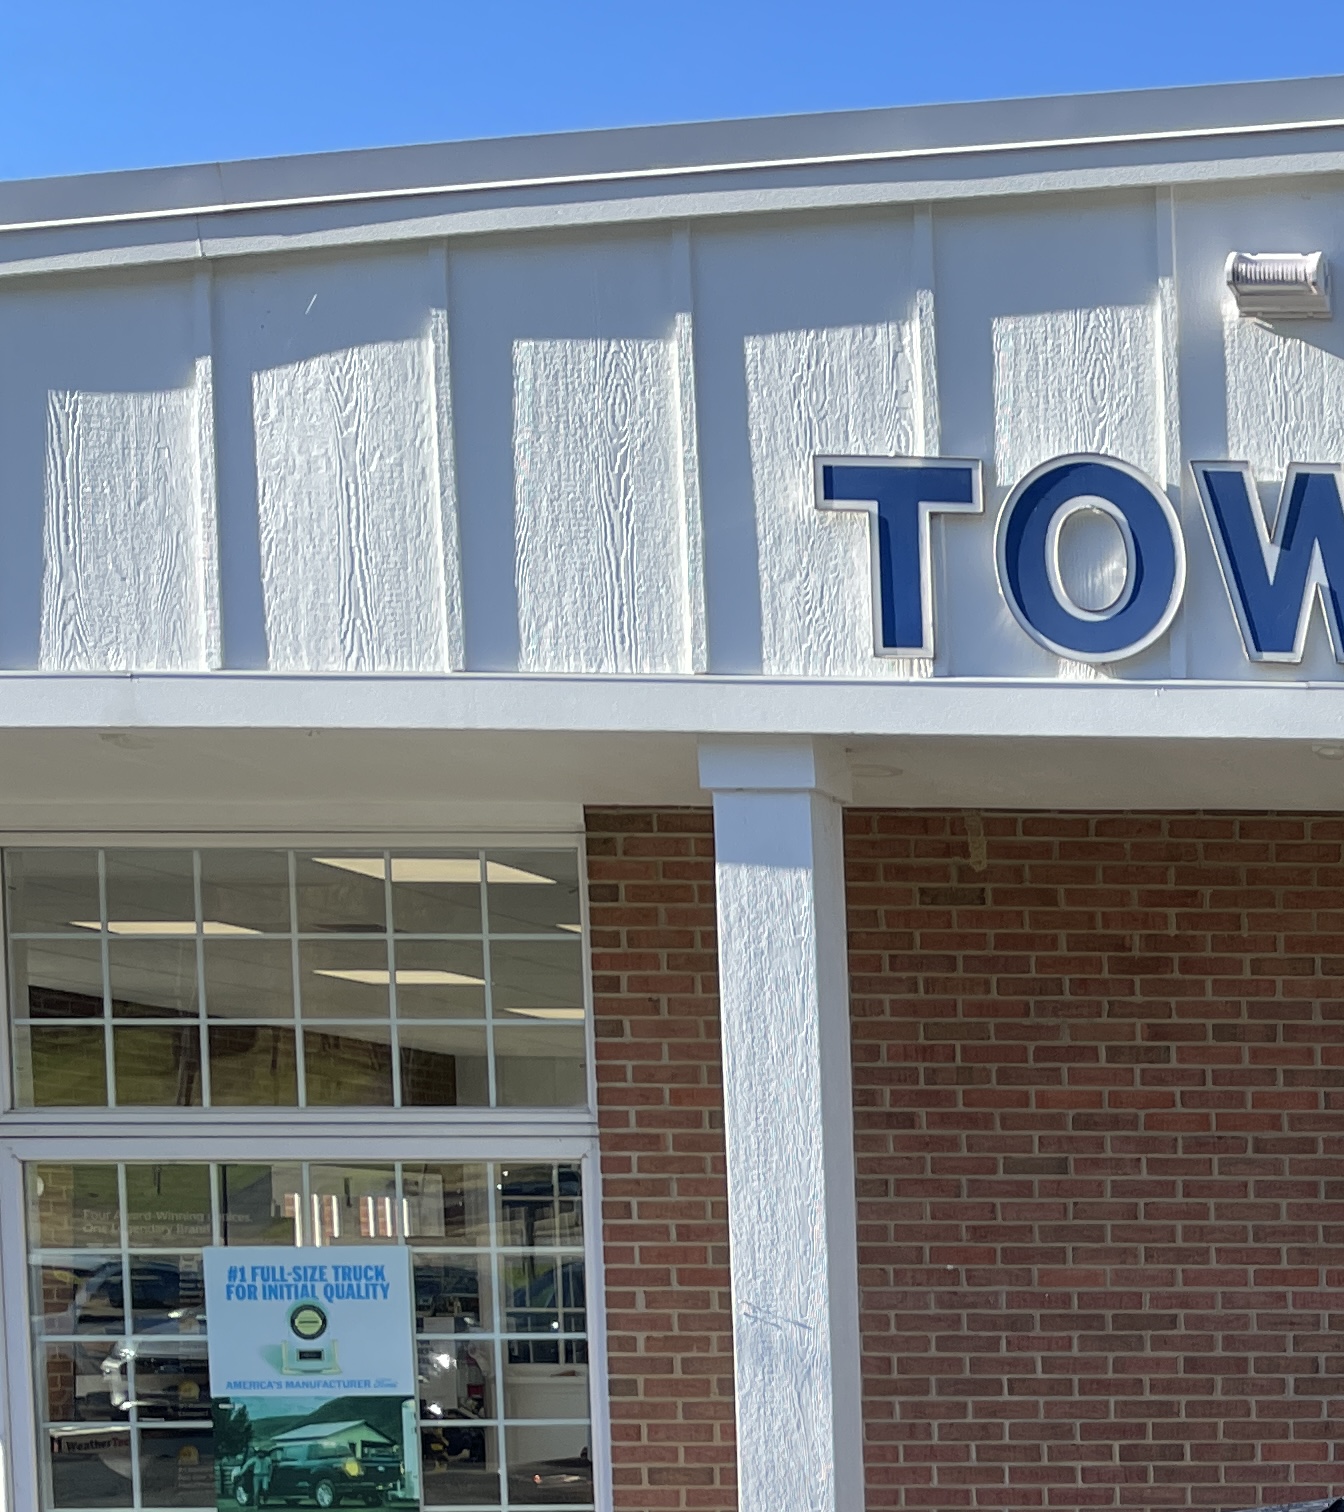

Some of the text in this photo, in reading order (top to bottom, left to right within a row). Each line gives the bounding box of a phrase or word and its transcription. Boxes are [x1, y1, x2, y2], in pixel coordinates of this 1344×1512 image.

[228, 1265, 386, 1283] #1 FULL-SIZE TRUCK
[225, 1283, 258, 1300] FOR
[262, 1283, 319, 1300] INITIAL
[323, 1282, 390, 1303] QUALITY
[225, 1380, 283, 1390] AMERICA'S
[285, 1379, 371, 1389] MANUFACTURER
[66, 1437, 130, 1452] WeatherTec
